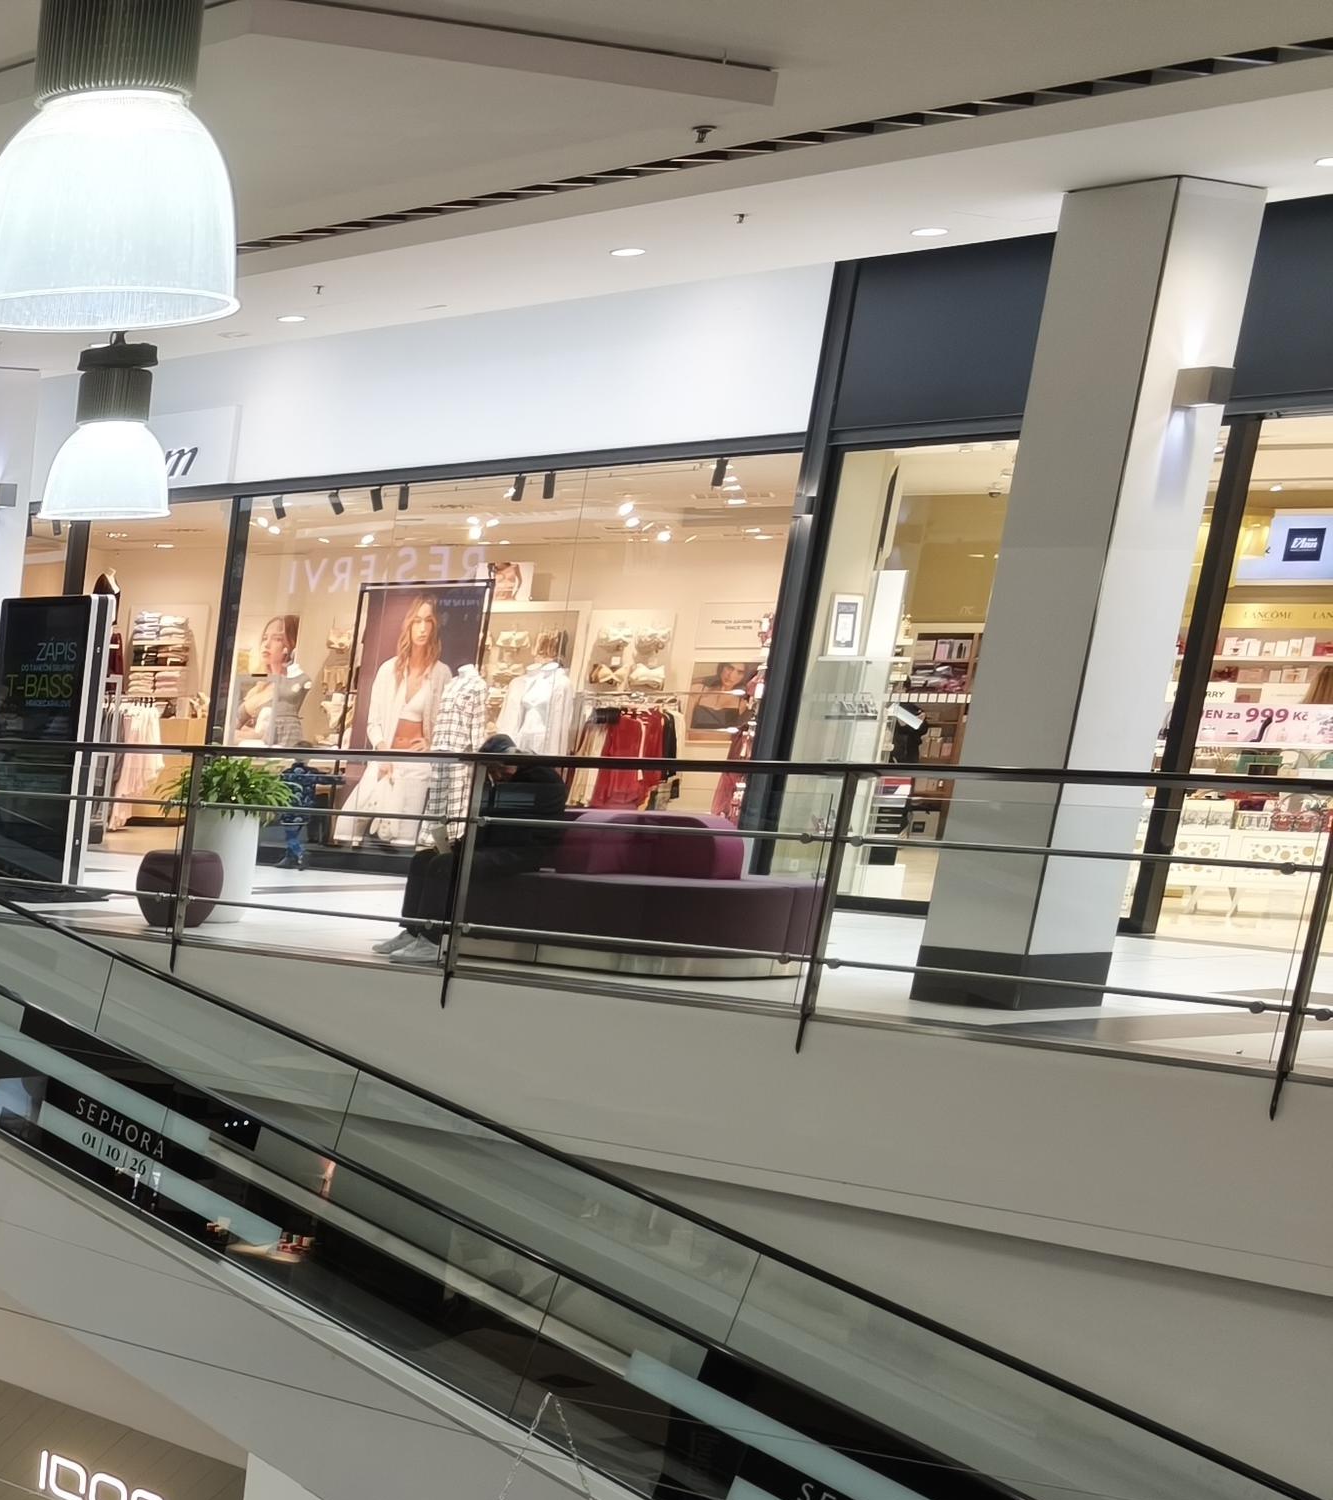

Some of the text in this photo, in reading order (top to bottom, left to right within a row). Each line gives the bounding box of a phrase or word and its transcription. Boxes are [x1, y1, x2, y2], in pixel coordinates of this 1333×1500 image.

[36, 636, 78, 662] ZÁPIS
[6, 673, 73, 699] T-BASS
[1226, 711, 1241, 719] za
[1245, 707, 1289, 723] 999
[1293, 711, 1308, 721] Kč
[76, 1097, 164, 1159] SEPHORA
[81, 1131, 96, 1148] 01
[106, 1145, 120, 1161] 10
[129, 1157, 148, 1176] 26
